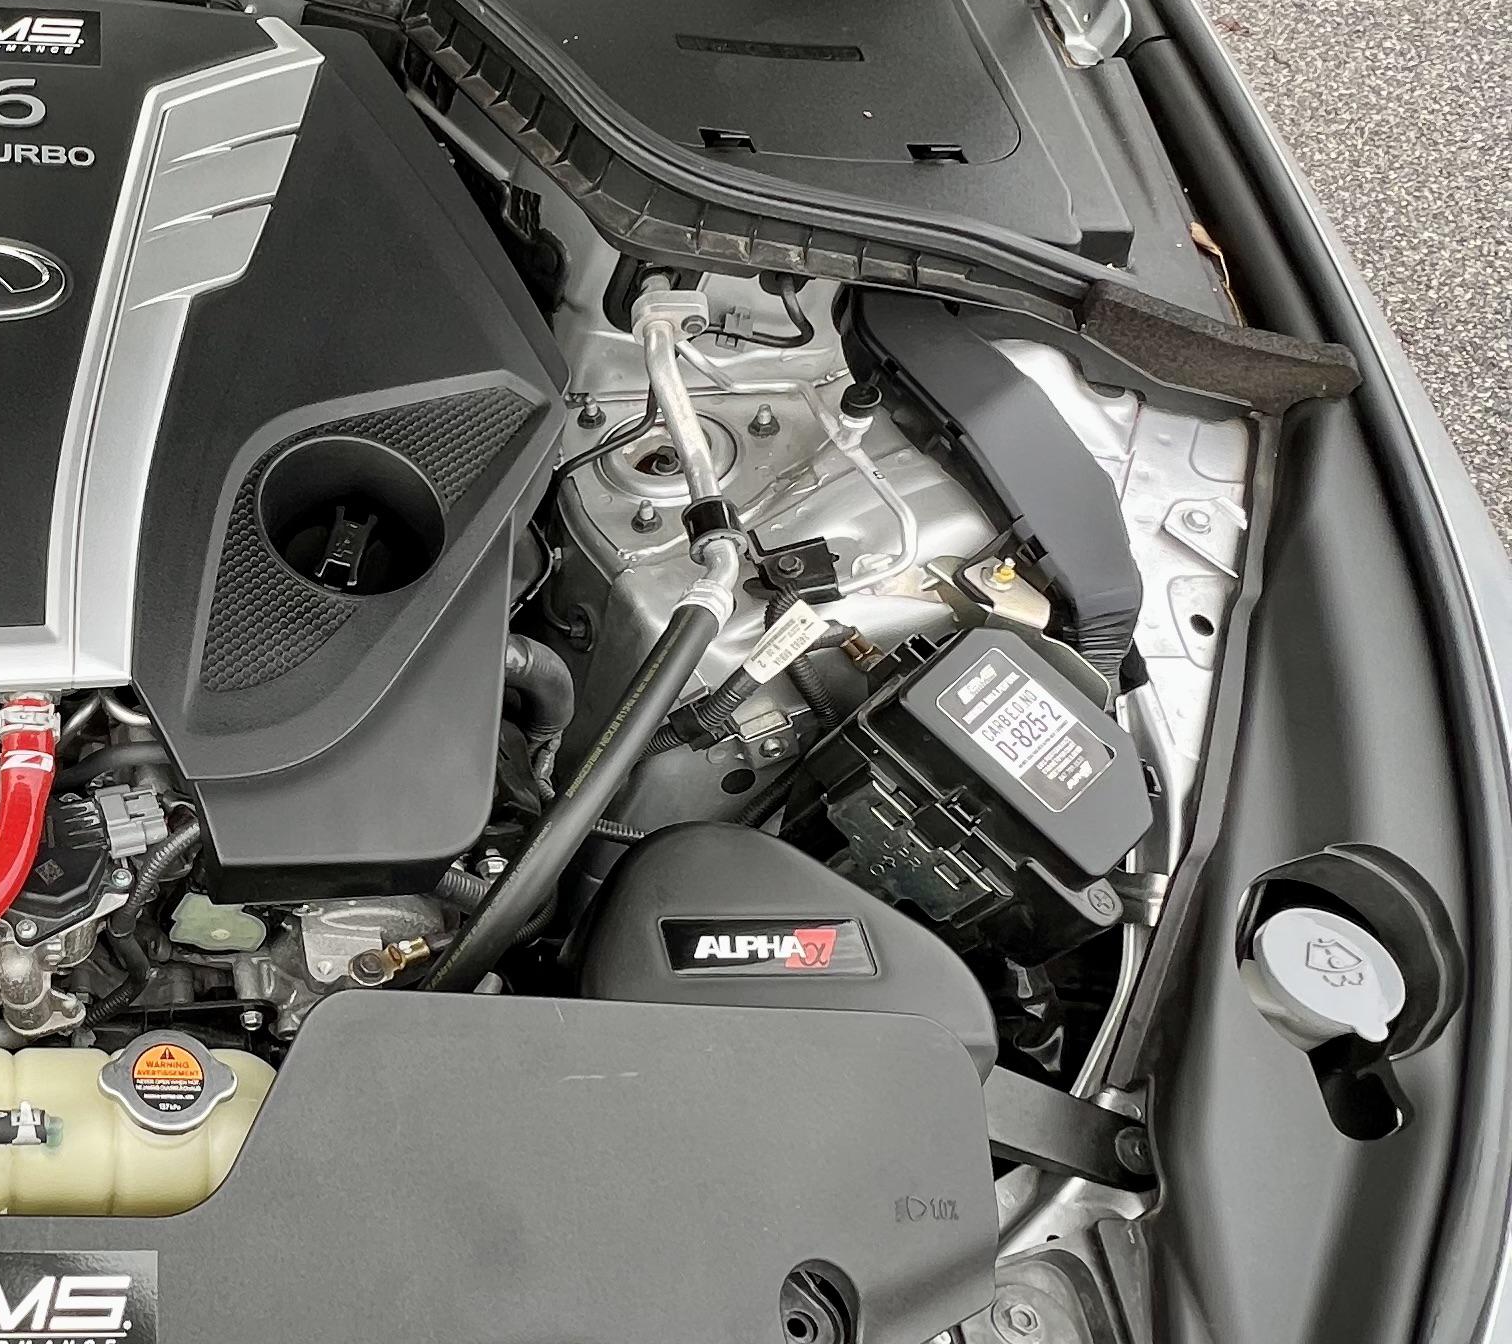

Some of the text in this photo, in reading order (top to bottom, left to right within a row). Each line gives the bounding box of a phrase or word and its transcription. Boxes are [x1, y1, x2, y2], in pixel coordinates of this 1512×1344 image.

[981, 714, 1011, 742] CARB
[995, 700, 1062, 763] D-825-2
[693, 934, 808, 959] ALPHA
[145, 1061, 190, 1069] WARNING
